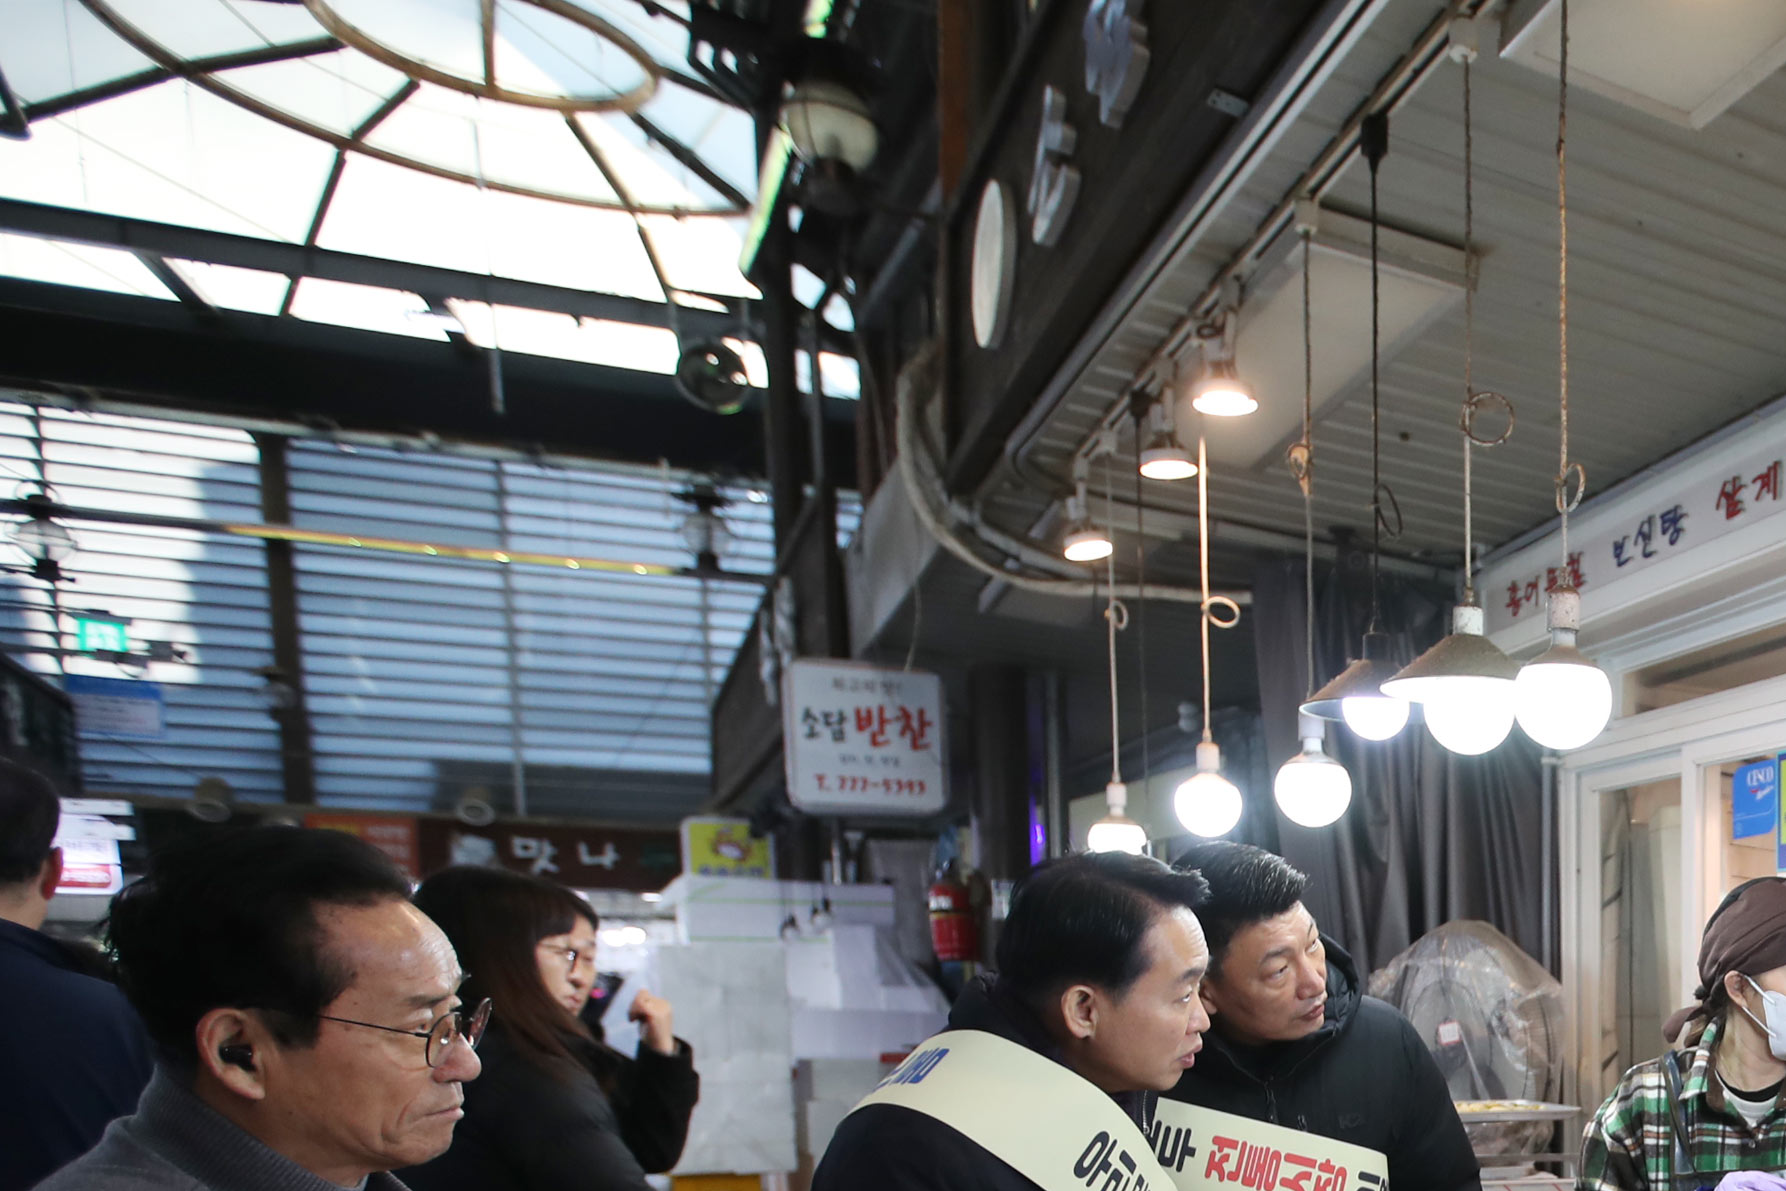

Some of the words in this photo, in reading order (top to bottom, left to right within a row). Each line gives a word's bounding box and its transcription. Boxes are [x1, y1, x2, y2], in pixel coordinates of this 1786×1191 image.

[1613, 504, 1689, 568] 보신탕
[802, 706, 847, 742] 소담
[855, 704, 933, 750] 반찬
